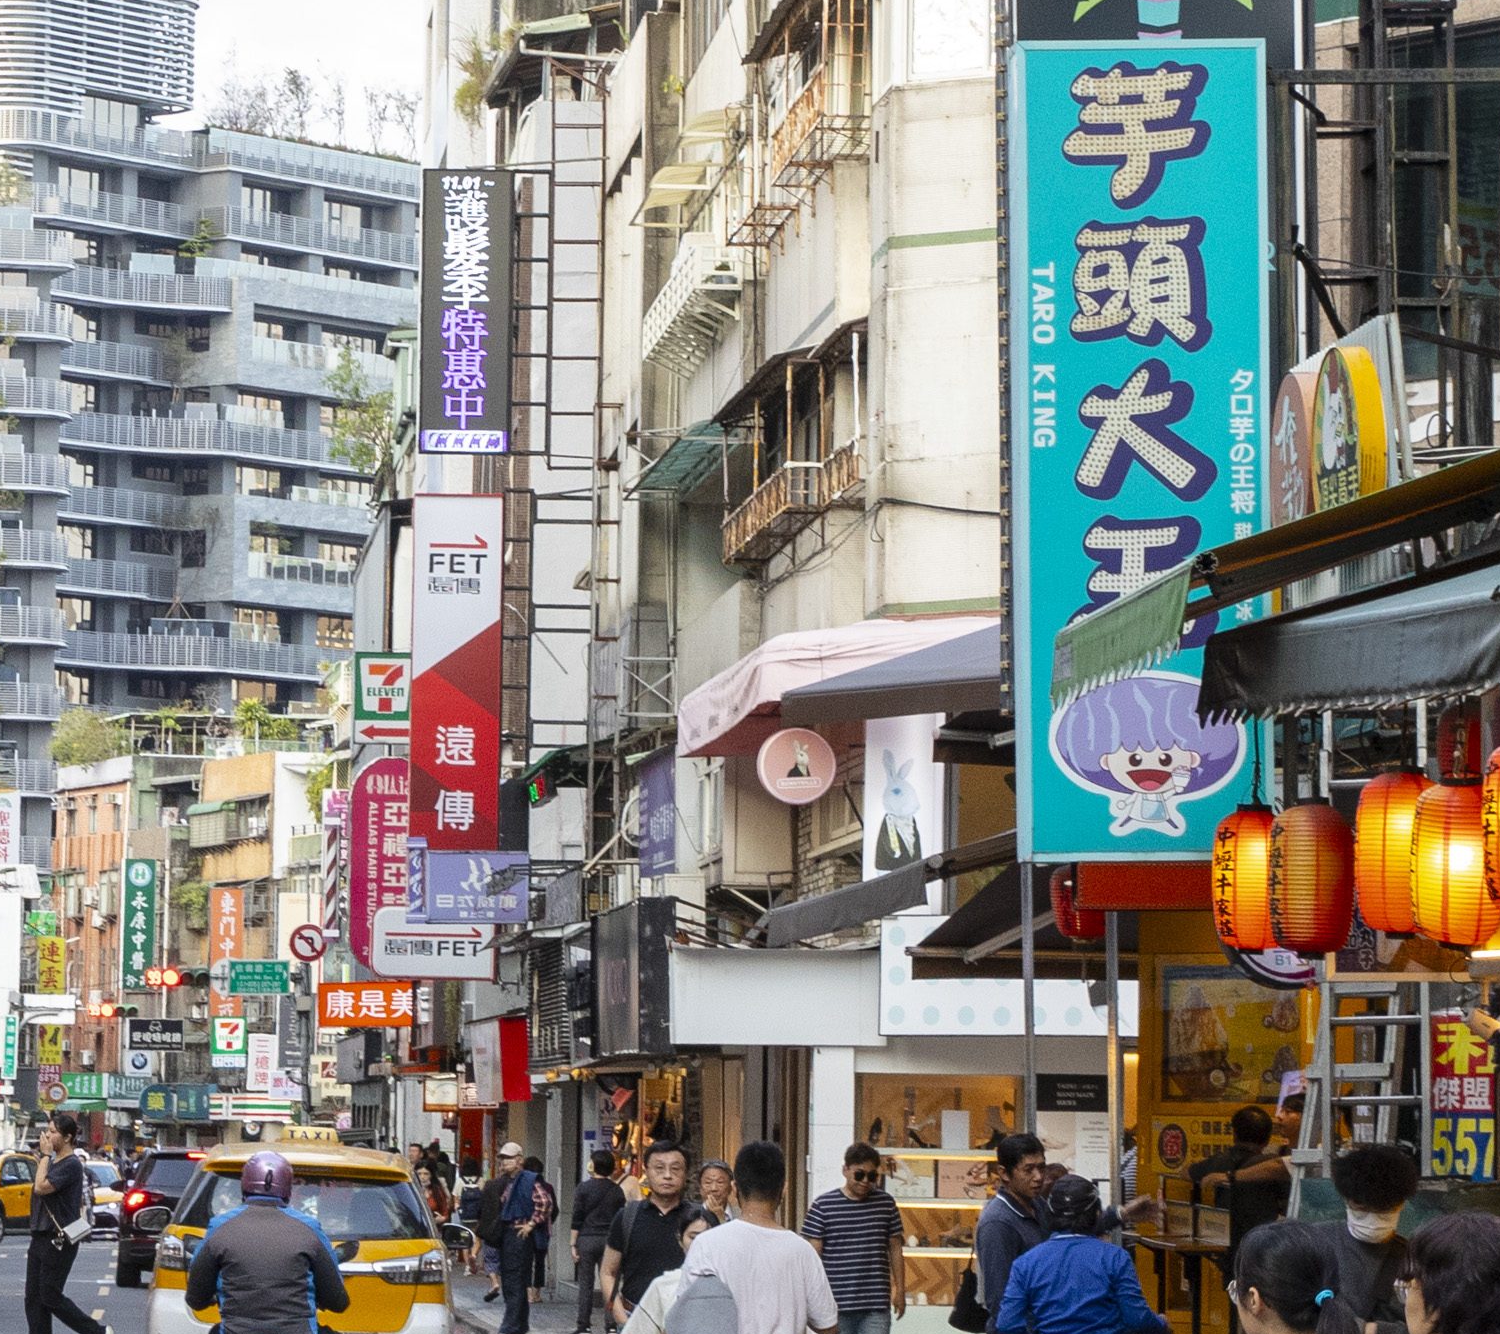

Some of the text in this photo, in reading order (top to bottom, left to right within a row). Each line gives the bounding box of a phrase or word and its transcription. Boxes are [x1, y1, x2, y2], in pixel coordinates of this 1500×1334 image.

[1032, 262, 1056, 449] TARO KING
[428, 553, 488, 574] FET
[434, 724, 476, 831] 遠傳
[129, 891, 149, 971] 永康中醫
[437, 940, 482, 957] FET
[1275, 955, 1292, 966] B1
[325, 988, 414, 1020] 康是美
[287, 1129, 335, 1143] TAXI
[1431, 1117, 1494, 1176] 557
